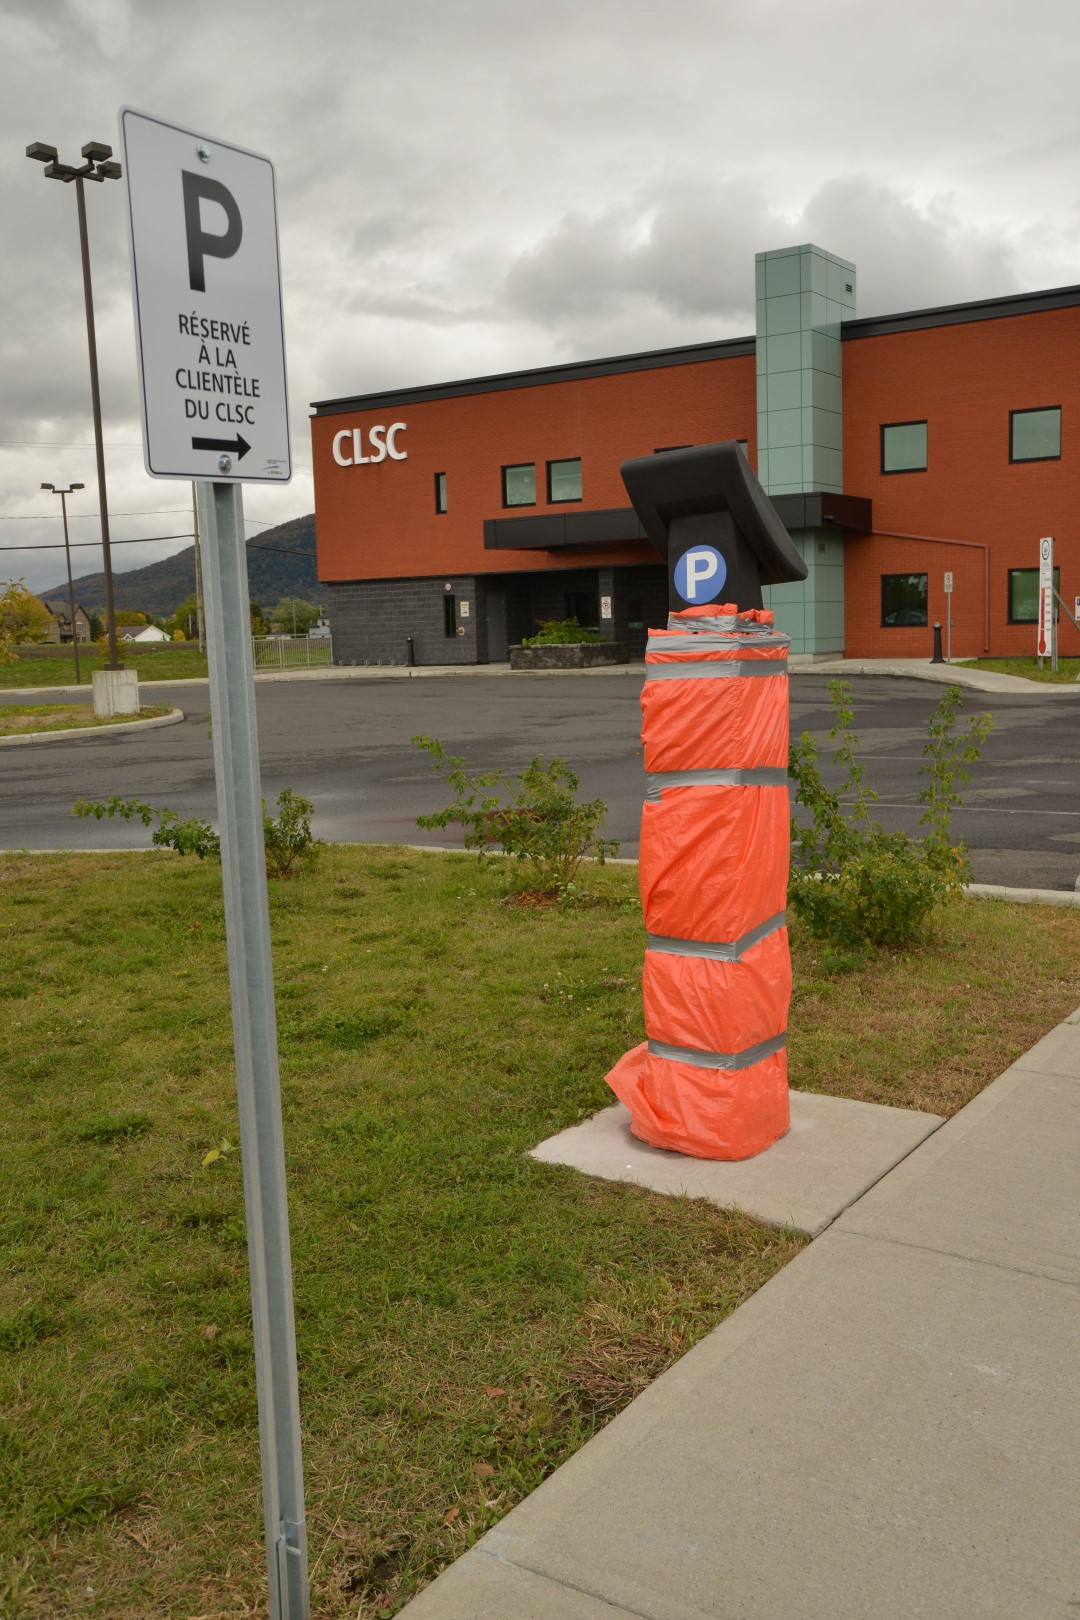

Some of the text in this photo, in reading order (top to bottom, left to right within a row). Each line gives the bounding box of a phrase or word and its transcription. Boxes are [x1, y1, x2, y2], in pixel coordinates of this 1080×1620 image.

[181, 169, 243, 293] P
[178, 310, 251, 346] RÉSERVÉ
[198, 338, 238, 369] À LA
[175, 368, 261, 398] CLIENTÈLE
[184, 398, 255, 425] DU CLSC
[332, 422, 408, 467] CLSC
[686, 550, 718, 599] P
